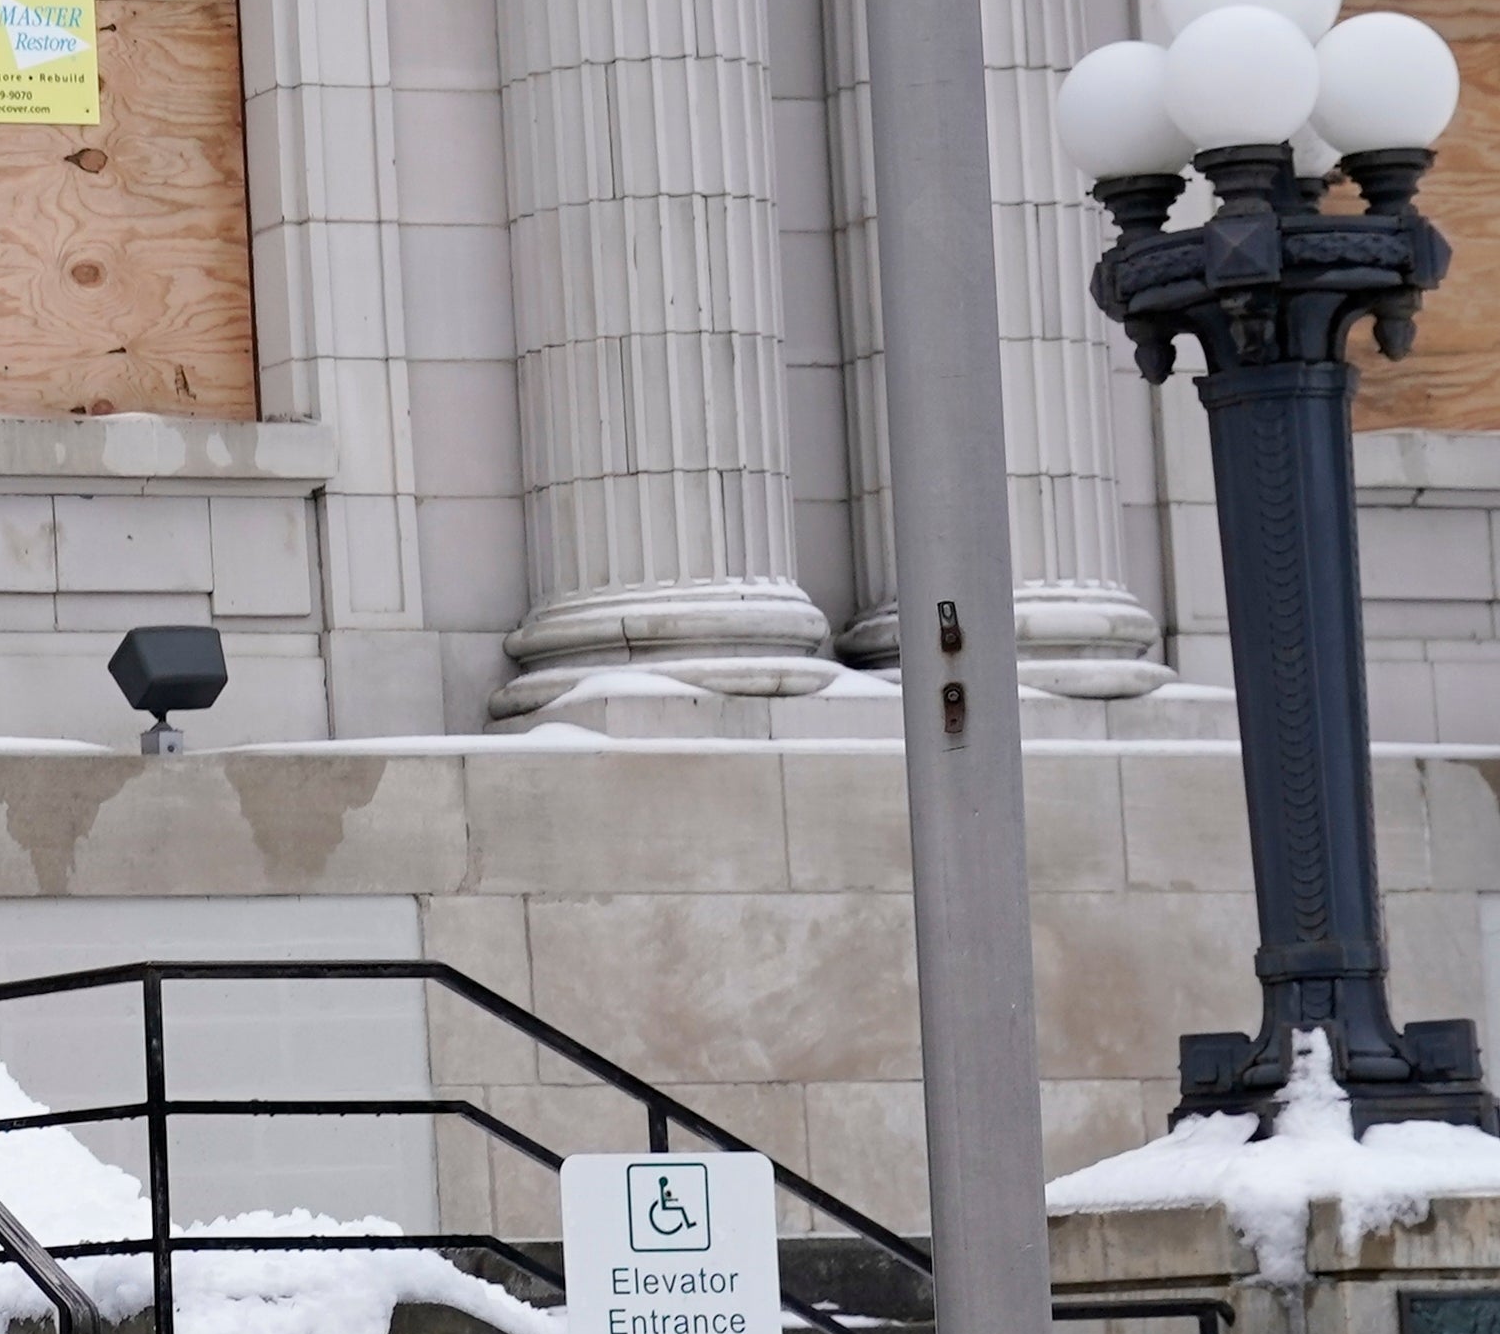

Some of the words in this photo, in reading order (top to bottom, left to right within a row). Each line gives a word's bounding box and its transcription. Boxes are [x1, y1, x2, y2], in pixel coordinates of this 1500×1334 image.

[15, 31, 77, 52] Restore
[40, 73, 85, 84] Rebuild
[612, 1267, 740, 1295] Elevator
